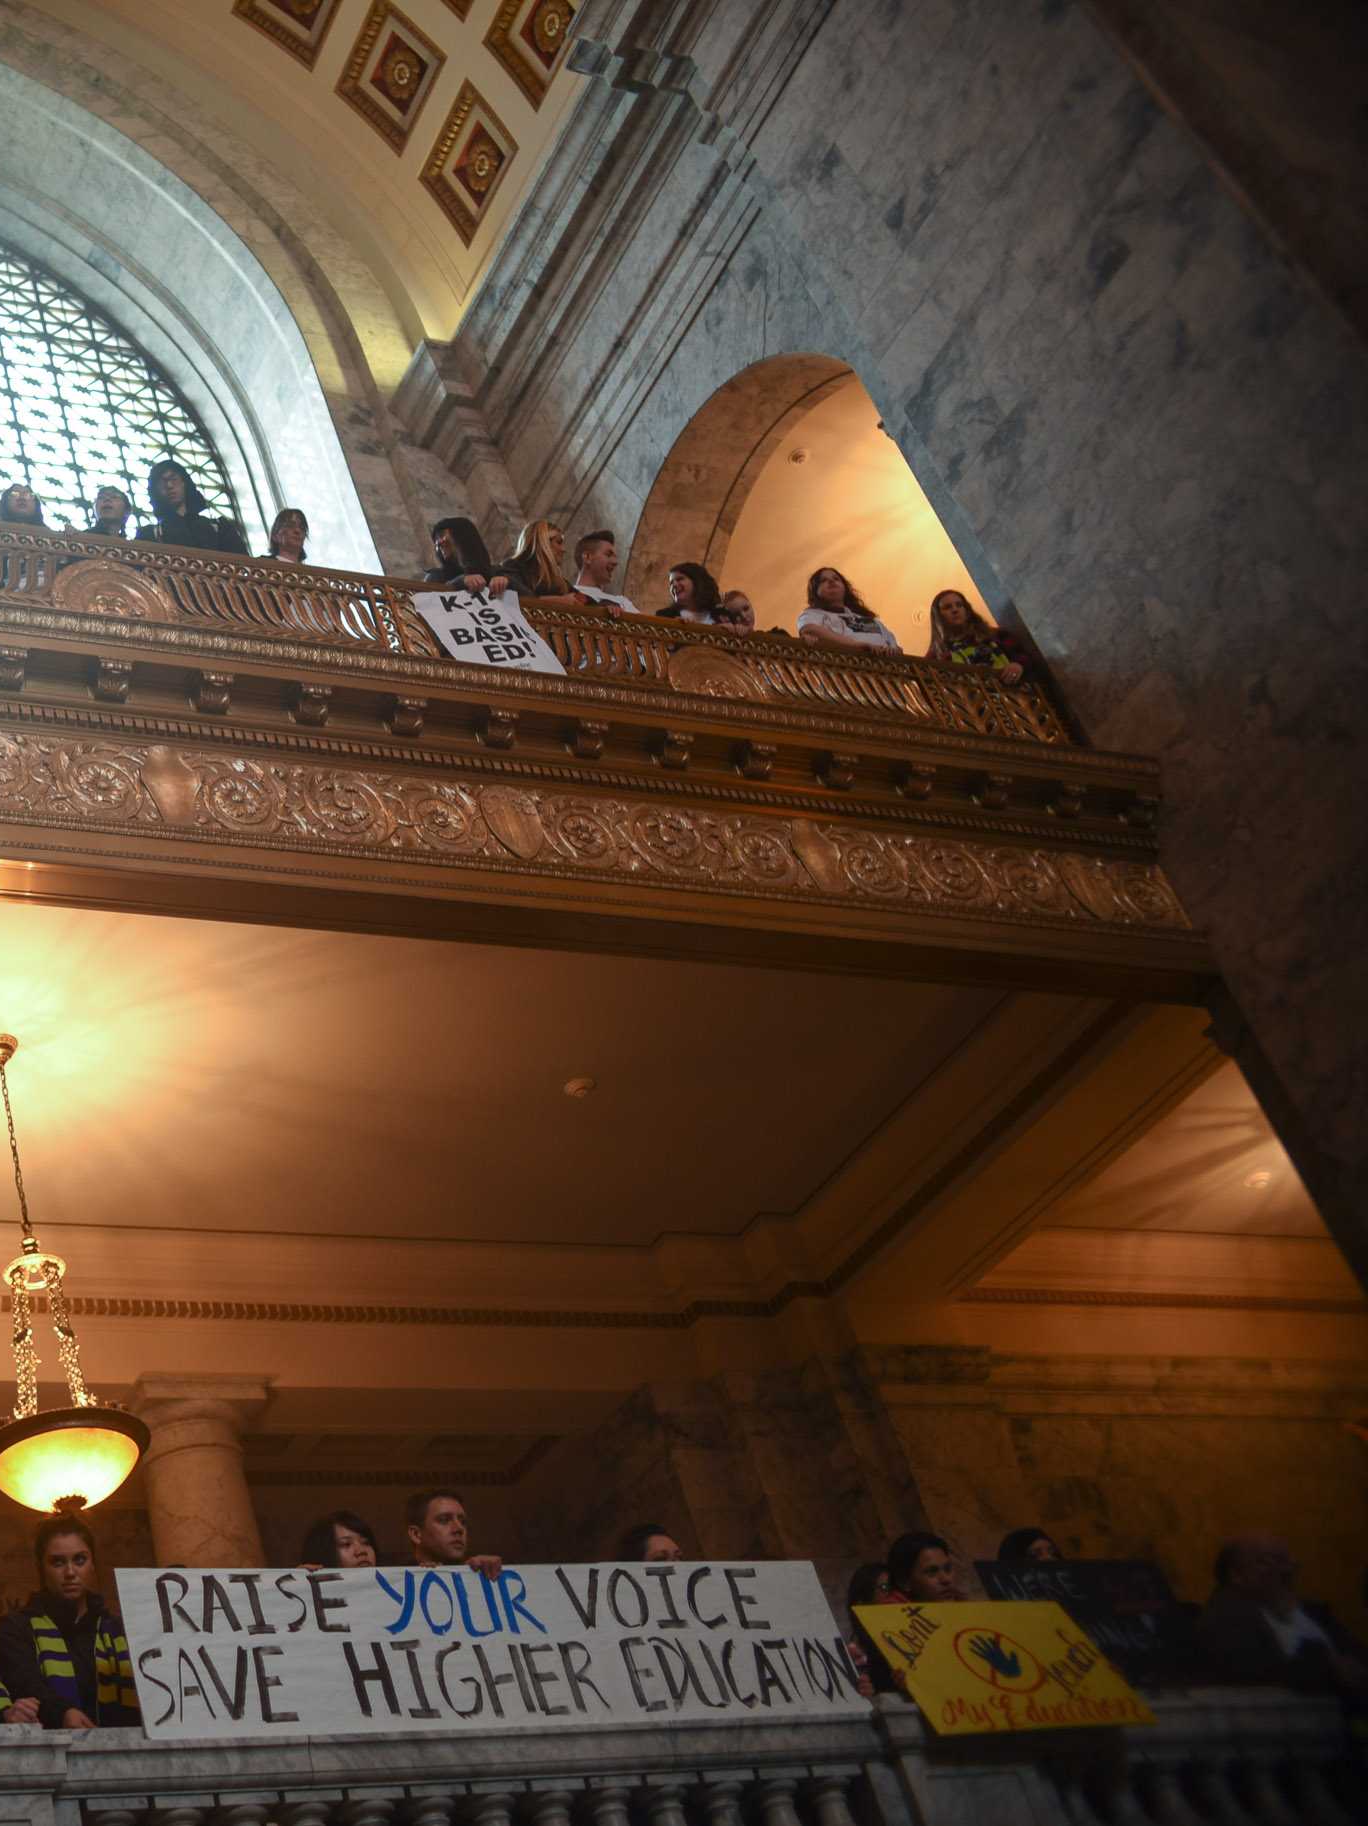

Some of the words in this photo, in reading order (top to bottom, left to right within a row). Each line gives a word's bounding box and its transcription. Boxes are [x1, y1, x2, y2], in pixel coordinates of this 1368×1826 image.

[439, 591, 497, 612] K-1
[467, 608, 501, 626] IS
[483, 641, 536, 663] ED!
[155, 1571, 351, 1635] RAISE
[375, 1567, 548, 1637] YOUR
[554, 1565, 771, 1630] VOICE
[138, 1644, 300, 1726] SAVE
[343, 1638, 612, 1719] HIGHER
[618, 1635, 862, 1713] EDUCATION
